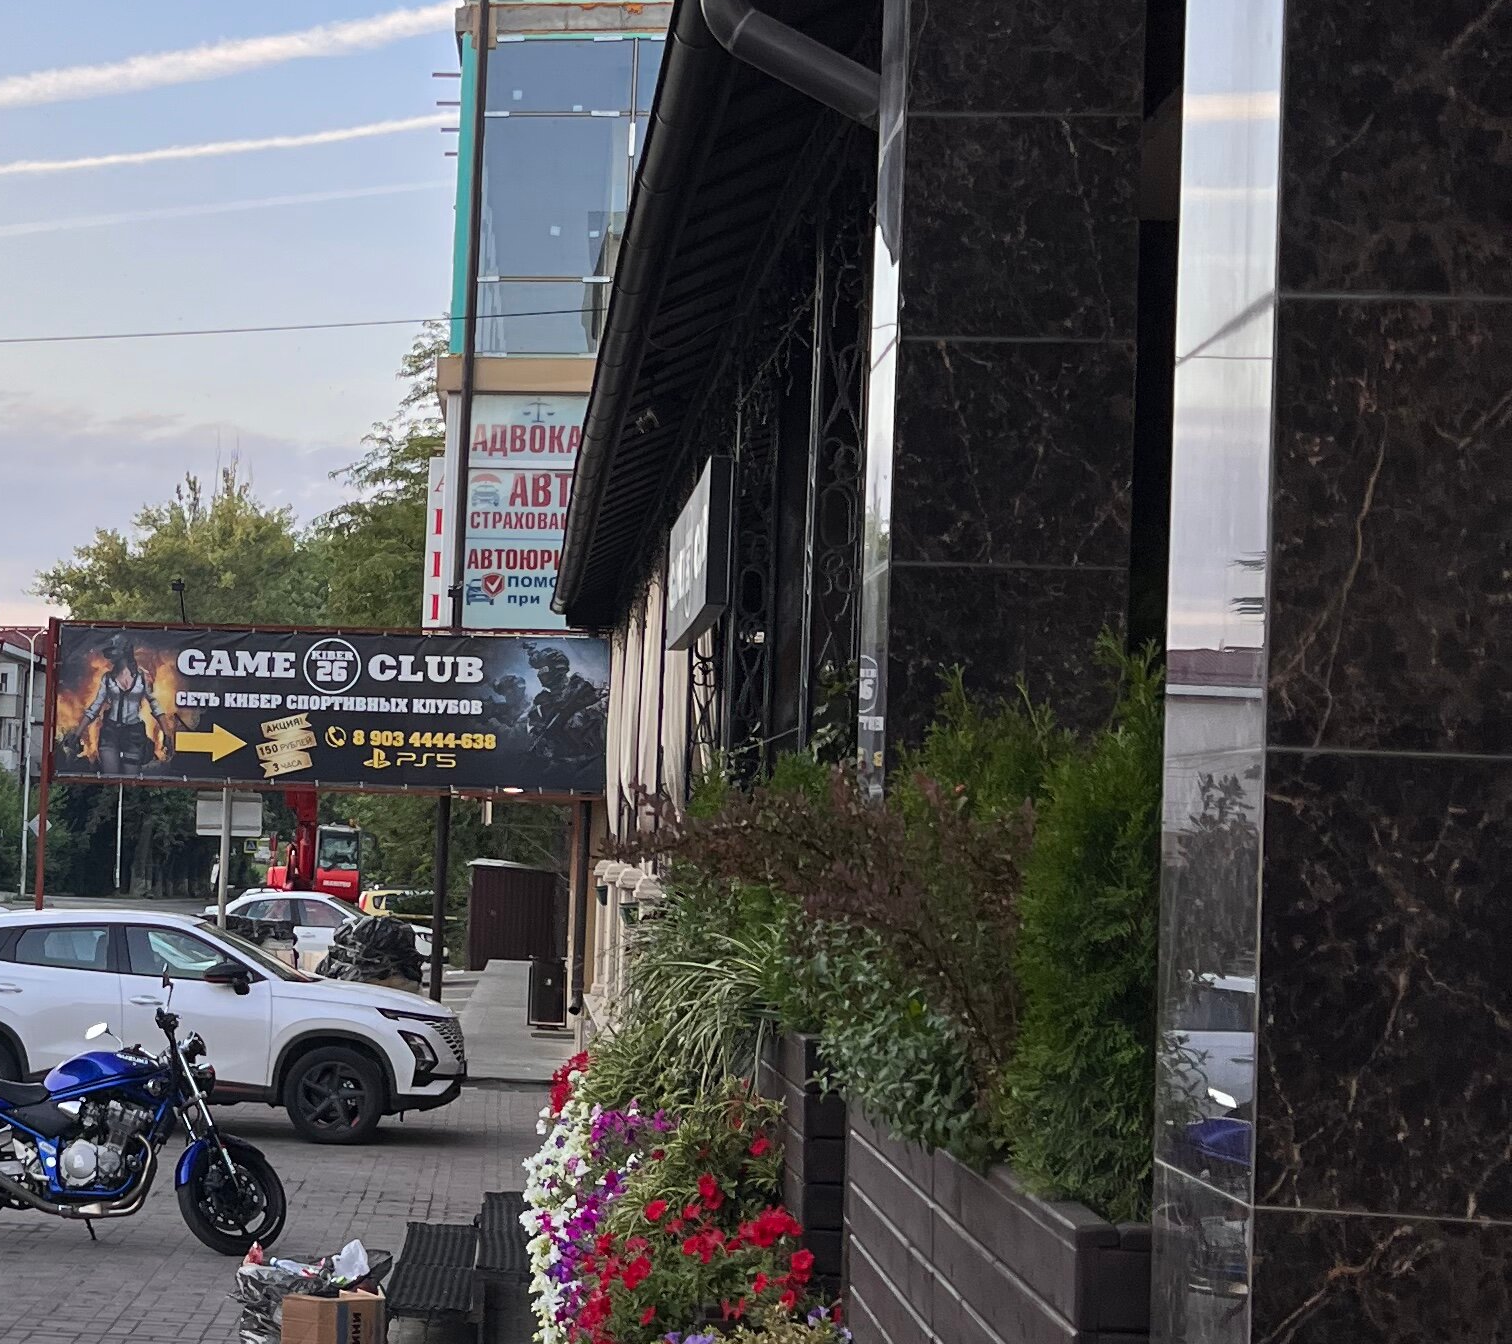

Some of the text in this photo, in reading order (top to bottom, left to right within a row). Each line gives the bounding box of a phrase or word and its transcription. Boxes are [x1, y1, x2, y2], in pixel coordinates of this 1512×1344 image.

[177, 648, 485, 683] GAME CLUB
[316, 660, 348, 682] 26
[175, 691, 484, 715] СЕТЬ КИБЕР СПОРТИВНЫХ КЛУБОВ
[266, 717, 304, 733] АКЦИЯ!
[259, 744, 279, 756] 150
[352, 730, 497, 750] 8 903 4444-638
[396, 752, 457, 768] PS5
